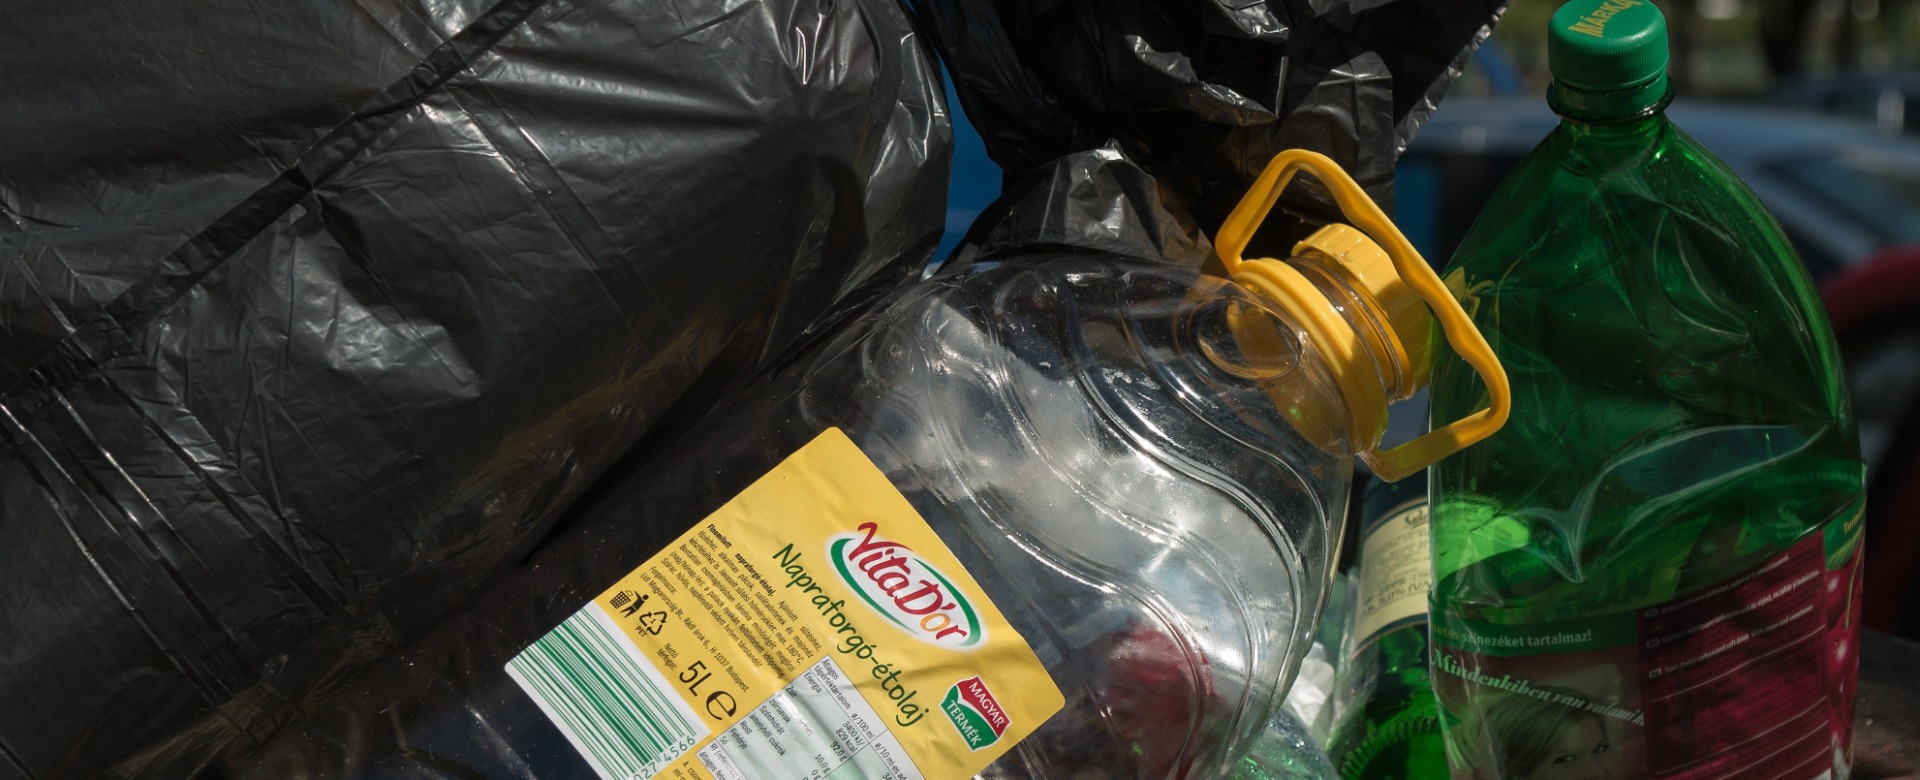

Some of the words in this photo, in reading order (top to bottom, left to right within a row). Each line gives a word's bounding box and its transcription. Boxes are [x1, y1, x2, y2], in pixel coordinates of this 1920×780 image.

[679, 543, 702, 566] Bontatlan
[700, 566, 735, 602] csomagolásban
[734, 602, 752, 621] tárolva
[706, 523, 732, 549] Finomított
[778, 600, 798, 622] Ajánlott
[706, 590, 725, 608] palack
[722, 606, 740, 626] nyakán
[717, 551, 739, 573] alkalmas
[785, 626, 794, 635] és
[792, 635, 814, 658] majonéz
[634, 625, 648, 637] PET
[710, 608, 726, 626] védett
[723, 623, 740, 642] helyen
[773, 542, 930, 727] Napraforgó-étolaj
[1527, 629, 1592, 647] tartalmaz!
[663, 642, 679, 659] Nettó
[678, 660, 712, 697] 5L
[821, 658, 839, 680] Átlagos
[1431, 648, 1550, 700] Mindenkiben
[759, 704, 785, 735] Szénhidrát
[768, 698, 791, 724] zsírsavak
[803, 671, 822, 694] Energia
[842, 720, 858, 737] 3400
[968, 680, 1005, 729] MAGYAR
[729, 727, 748, 750] Fehérje
[739, 720, 753, 735] Rost
[749, 713, 772, 738] amelyből
[768, 737, 786, 756] cukrok
[865, 730, 875, 740] ml
[946, 699, 982, 747] TERMÉK
[719, 735, 729, 745] Só
[835, 727, 848, 741] 829
[844, 738, 858, 753] kcal
[681, 760, 689, 768] A
[696, 751, 717, 774] átlagos
